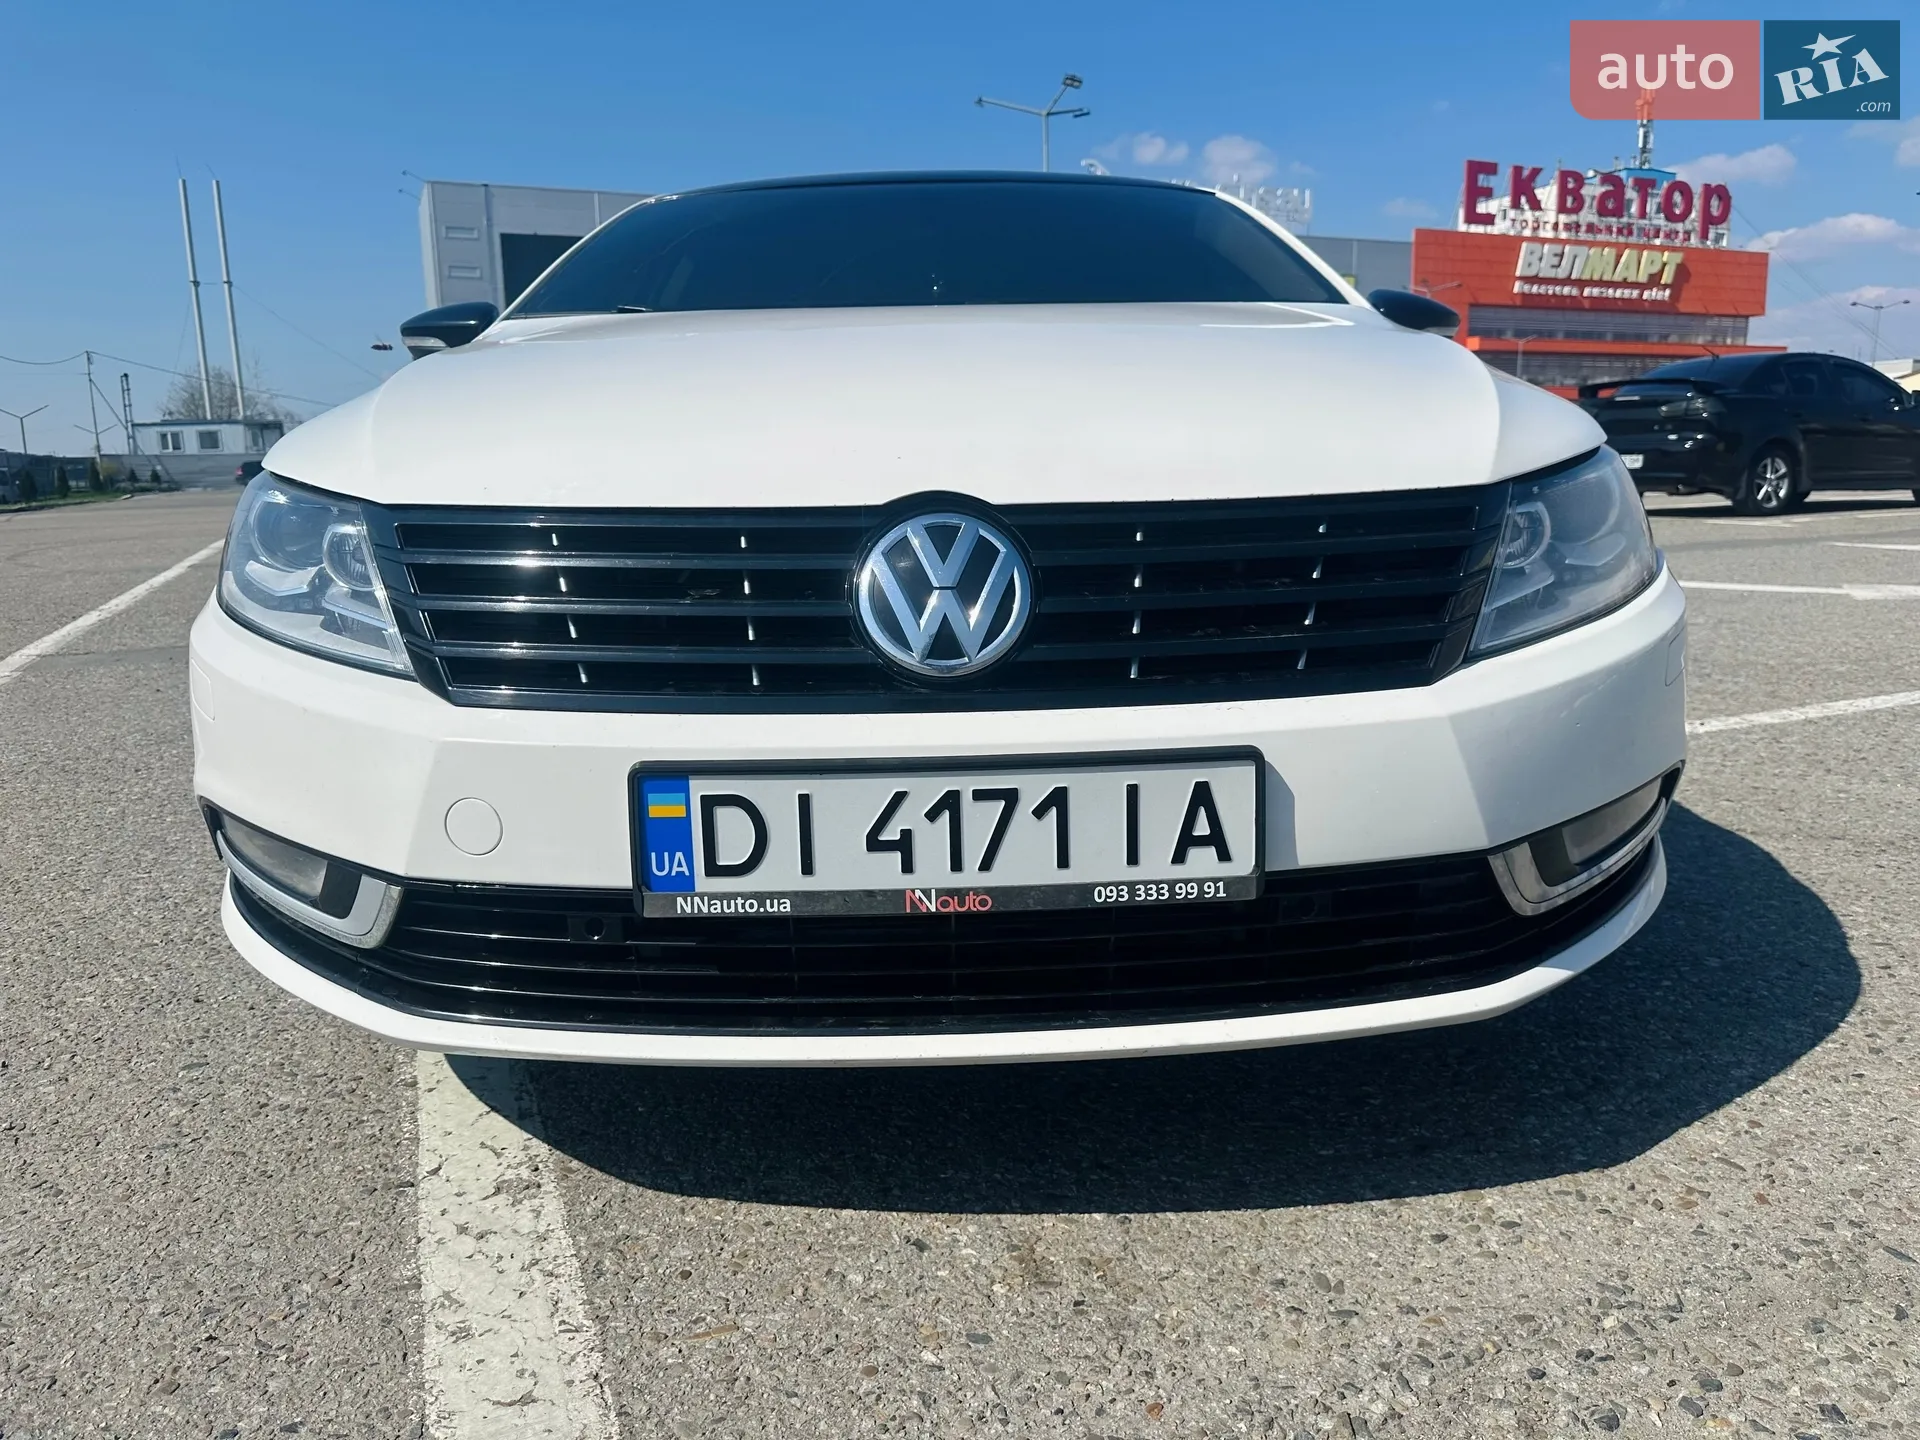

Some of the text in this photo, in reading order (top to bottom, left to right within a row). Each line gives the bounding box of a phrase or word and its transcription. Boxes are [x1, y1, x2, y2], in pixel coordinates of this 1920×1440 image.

[1514, 240, 1684, 285] ВЕЛМАРТ
[699, 779, 1233, 877] DI 4171 IA
[650, 851, 690, 877] UA
[1093, 880, 1227, 903] 093 333 99 91
[675, 895, 792, 915] NNauto.ua
